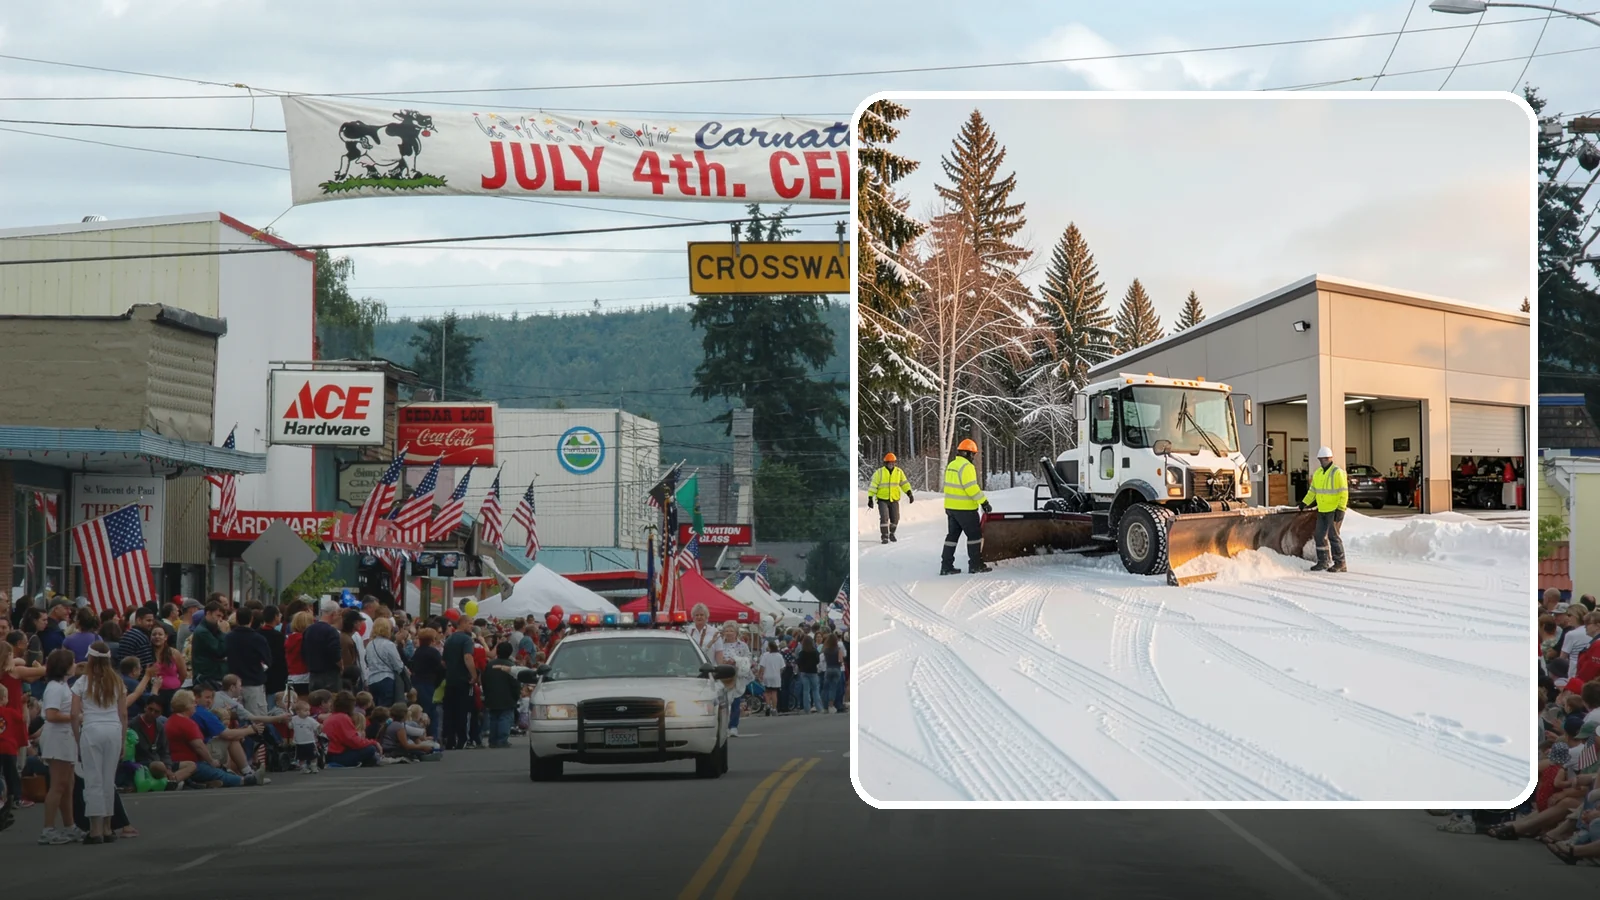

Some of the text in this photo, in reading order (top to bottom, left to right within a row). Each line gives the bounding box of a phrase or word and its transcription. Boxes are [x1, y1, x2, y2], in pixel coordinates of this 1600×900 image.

[481, 141, 604, 192] JULY
[632, 150, 746, 198] 4th.
[697, 254, 850, 280] CROSSWA
[283, 380, 373, 420] ACE
[405, 409, 452, 422] CEDAR
[283, 421, 370, 436] Hardware
[416, 428, 476, 447] Coca-Cola
[353, 467, 385, 480] Simpl
[83, 485, 155, 495] St. Vincent de Paul
[688, 526, 741, 535] CRNATION
[699, 535, 730, 543] GLASS
